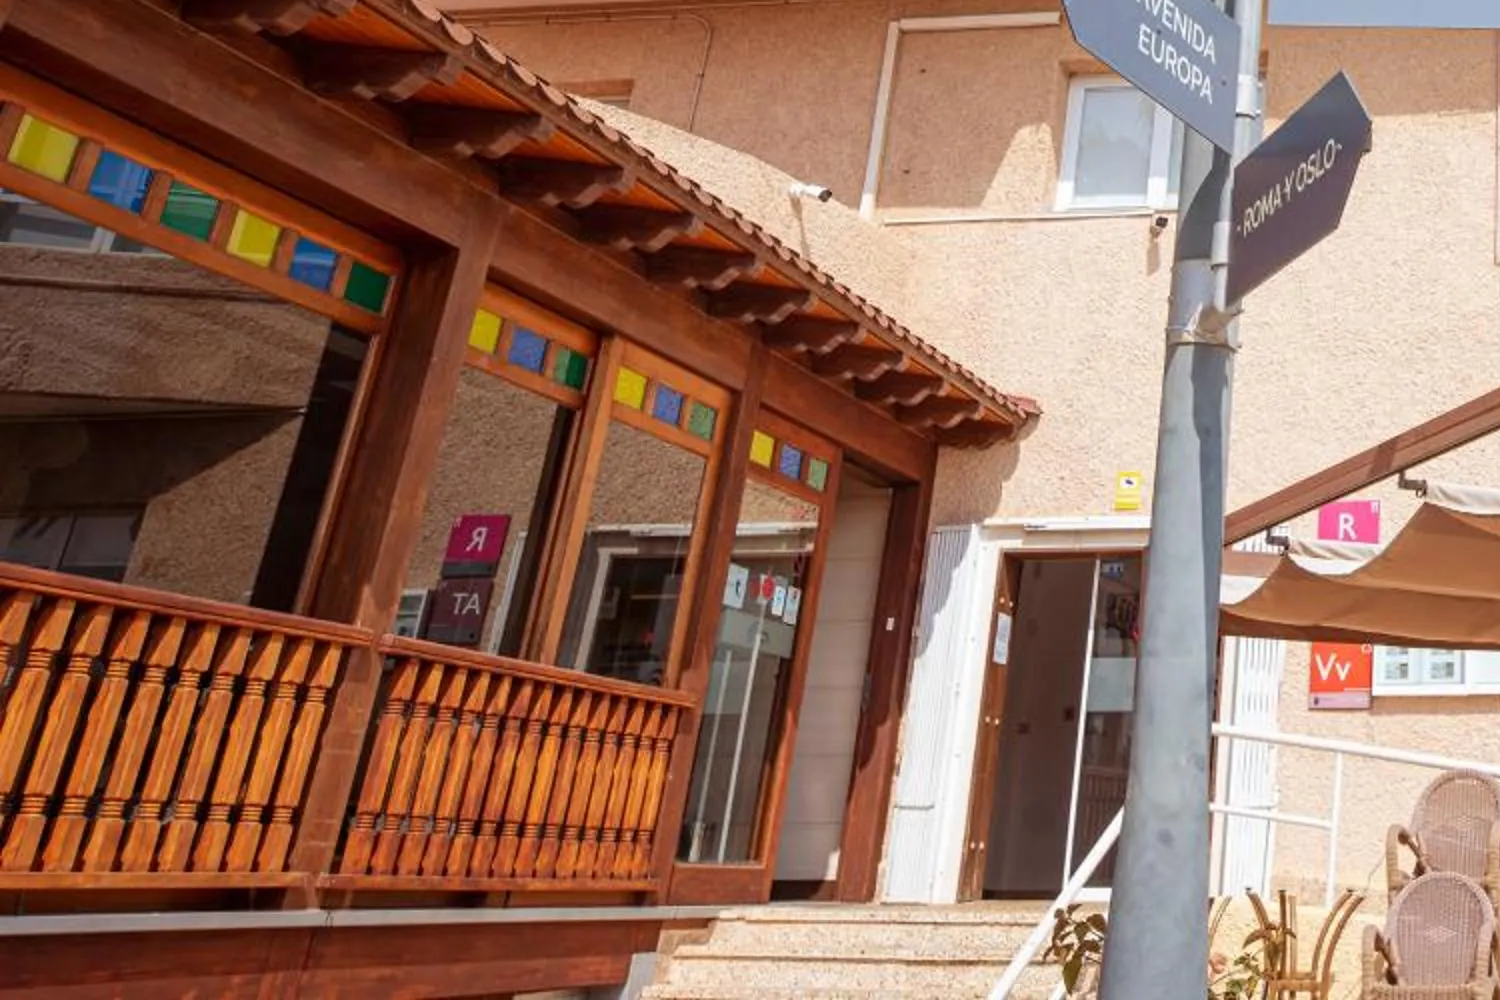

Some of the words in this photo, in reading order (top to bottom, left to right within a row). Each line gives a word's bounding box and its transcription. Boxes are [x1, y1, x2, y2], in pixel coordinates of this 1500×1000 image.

[1137, 23, 1214, 105] EUROPA
[1242, 183, 1284, 239] ROMA
[1284, 169, 1295, 203] Y
[1295, 137, 1336, 193] OSLO
[1338, 511, 1357, 540] R
